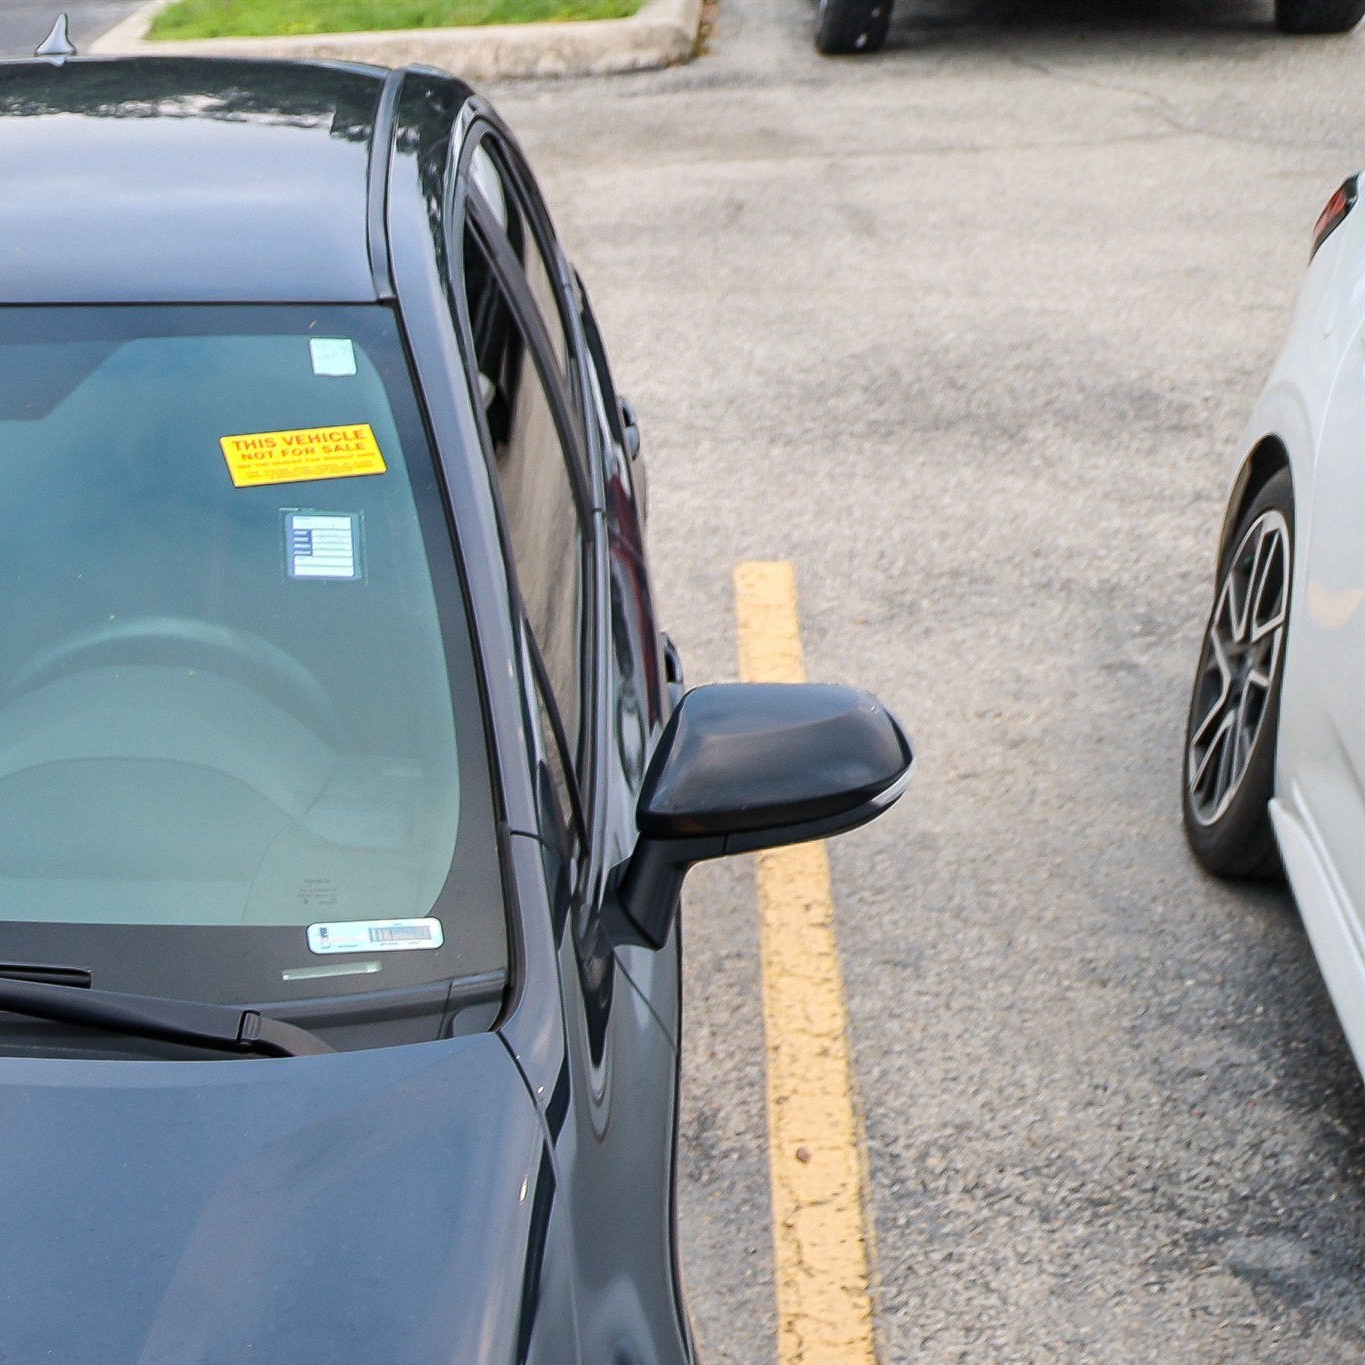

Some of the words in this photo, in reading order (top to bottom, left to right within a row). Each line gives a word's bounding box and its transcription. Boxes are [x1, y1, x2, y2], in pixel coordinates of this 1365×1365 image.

[233, 438, 277, 450] THIS
[282, 430, 367, 446] VEHICLE
[241, 450, 275, 461] NOT
[281, 447, 315, 458] FOR
[322, 443, 366, 452] SALE
